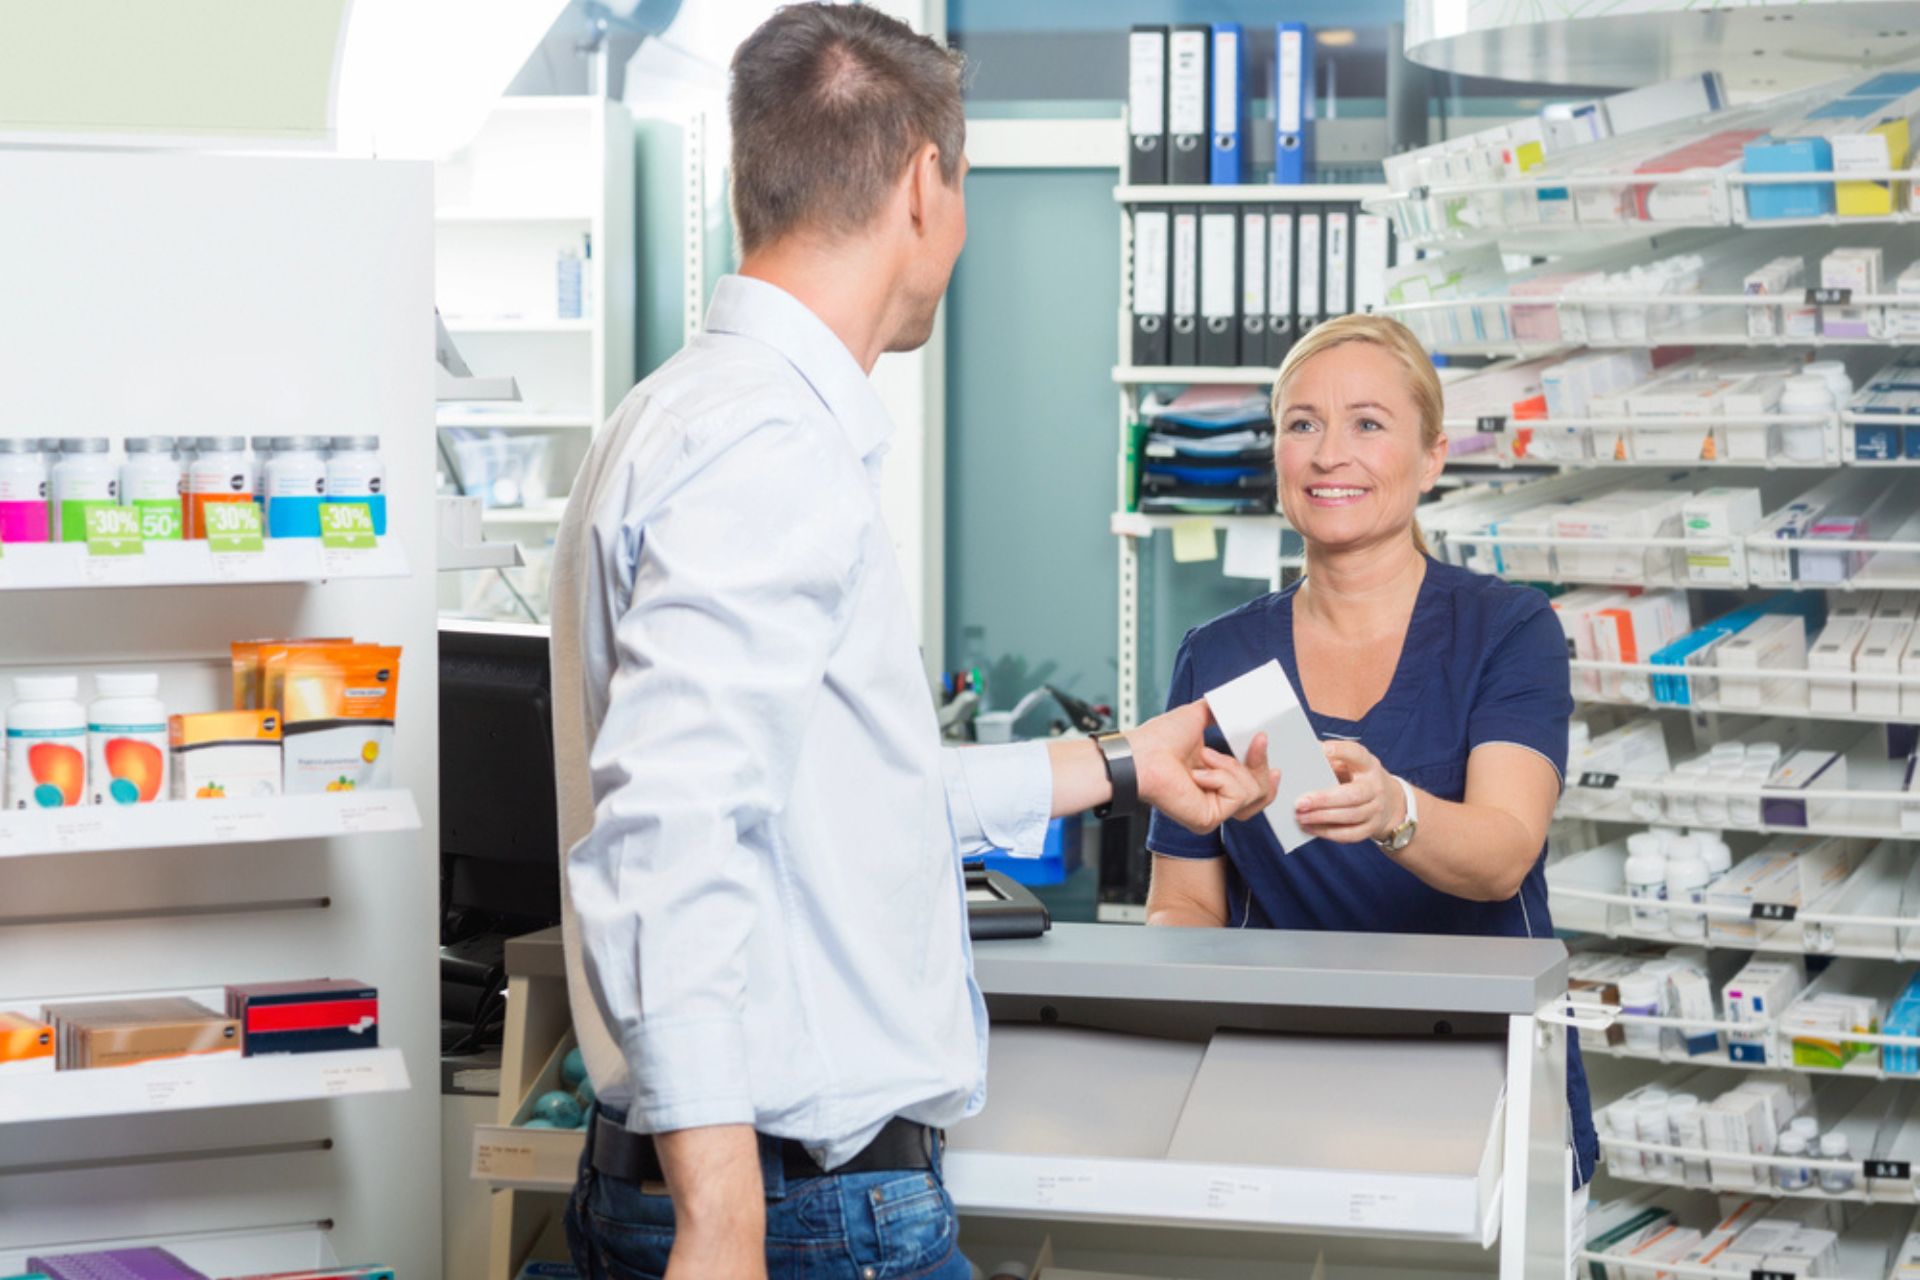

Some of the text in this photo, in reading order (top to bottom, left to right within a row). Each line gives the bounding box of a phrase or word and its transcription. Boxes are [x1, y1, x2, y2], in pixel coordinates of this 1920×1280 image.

[88, 508, 138, 534] -30%
[209, 505, 258, 531] -30%
[323, 506, 371, 530] -30%
